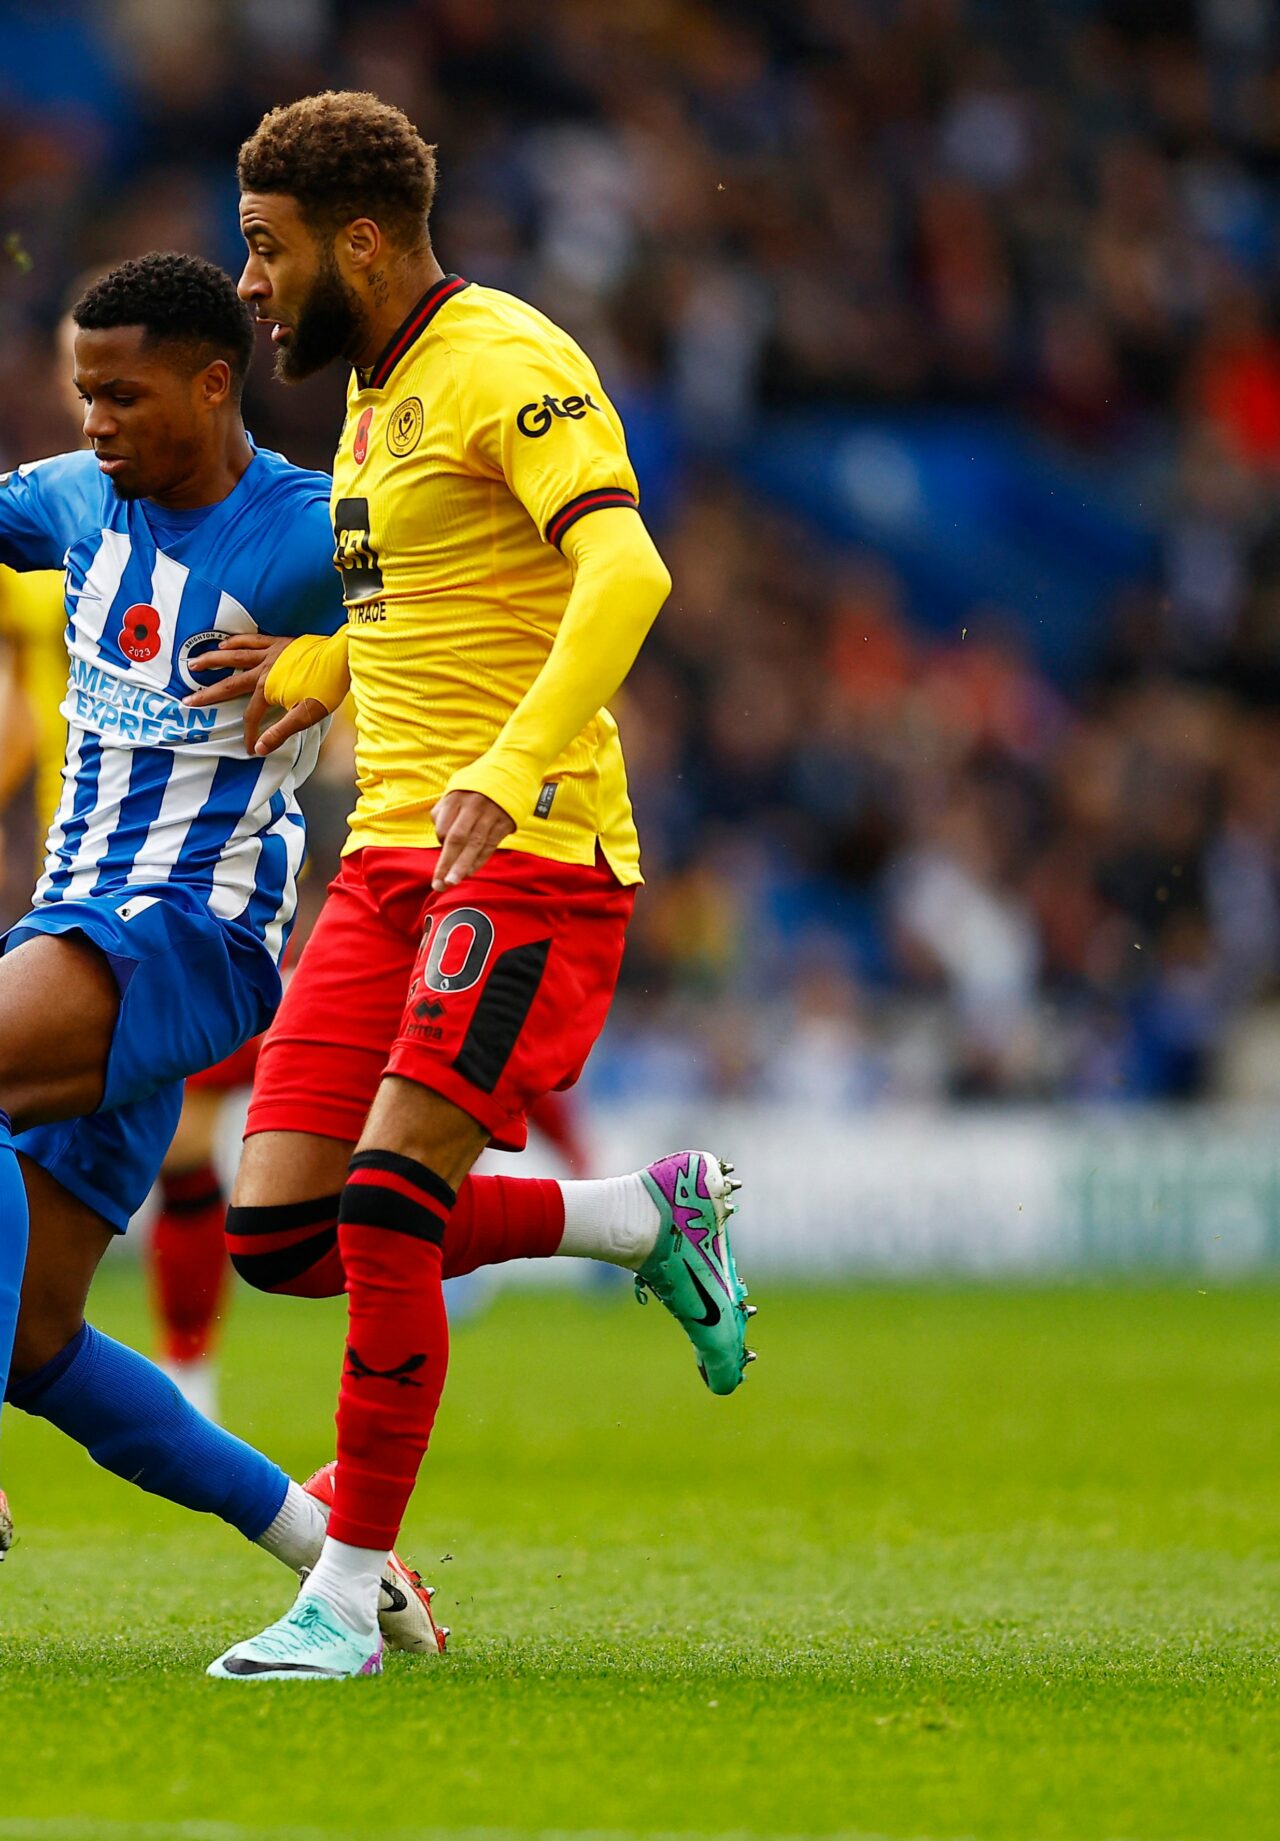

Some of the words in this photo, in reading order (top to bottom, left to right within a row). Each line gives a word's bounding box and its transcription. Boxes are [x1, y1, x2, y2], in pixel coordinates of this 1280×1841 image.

[349, 601, 387, 625] TRADE
[128, 645, 151, 658] 2023
[184, 632, 216, 649] BRIGHTON
[70, 655, 218, 730] AMERICAN
[76, 689, 212, 745] EXPRESS
